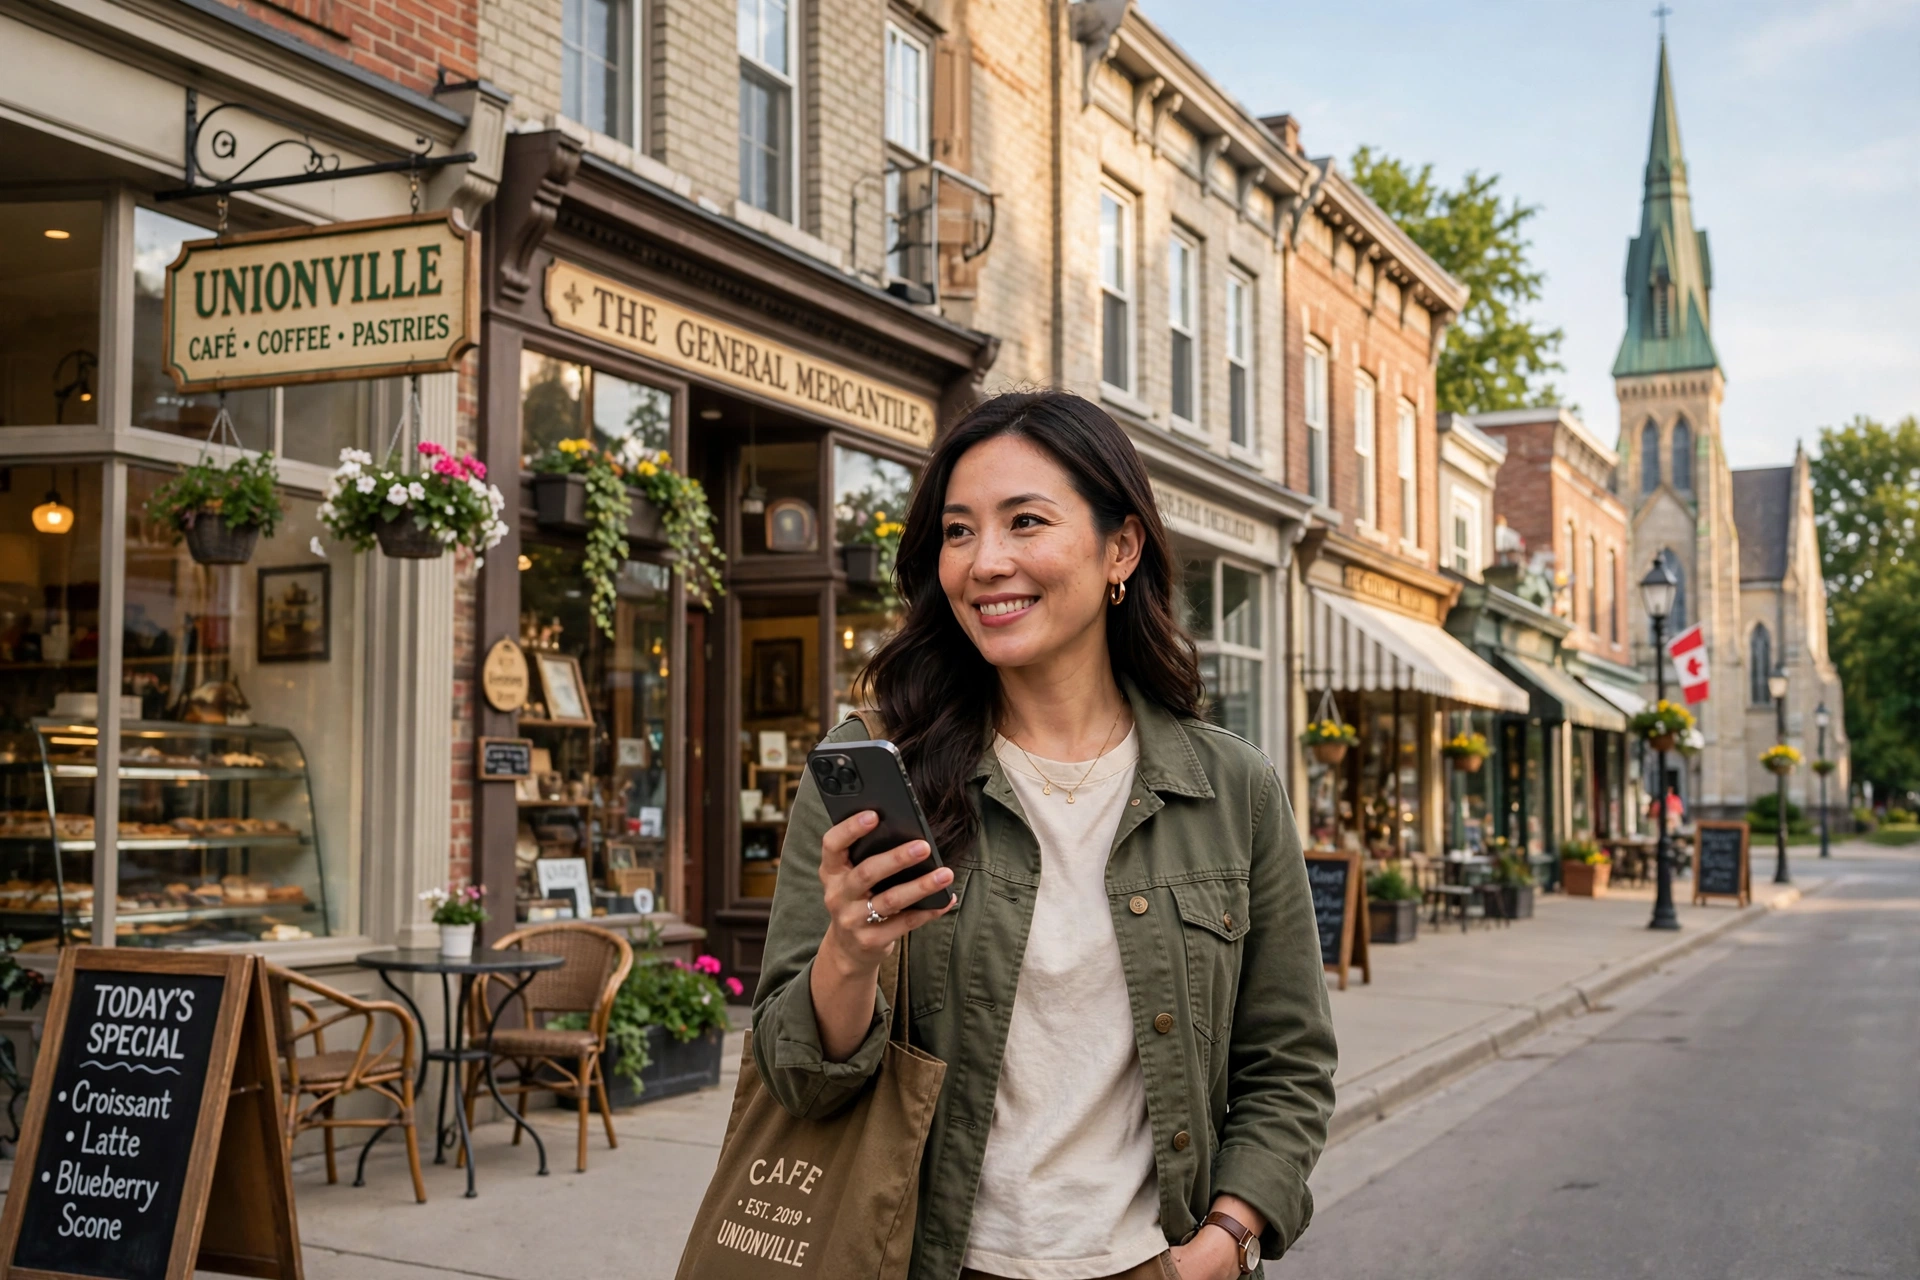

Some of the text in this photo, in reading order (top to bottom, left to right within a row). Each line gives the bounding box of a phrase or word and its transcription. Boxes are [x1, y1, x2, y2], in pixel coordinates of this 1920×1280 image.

[193, 243, 443, 319] UNIONVILLE
[188, 313, 450, 362] CAFÉ COFFEE PASTRIES
[593, 286, 921, 436] THE GENERAL MERCANTILE
[94, 984, 196, 1023] TODAY'S
[86, 1022, 185, 1060] SPECIAL
[71, 1079, 172, 1120] Croissant
[81, 1120, 141, 1157] Latte
[55, 1159, 160, 1213] Blueberry
[749, 1157, 823, 1195] CAFE
[58, 1202, 122, 1241] Scone
[744, 1197, 803, 1226] EST. 2019
[717, 1219, 810, 1268] UNIONVILLE
